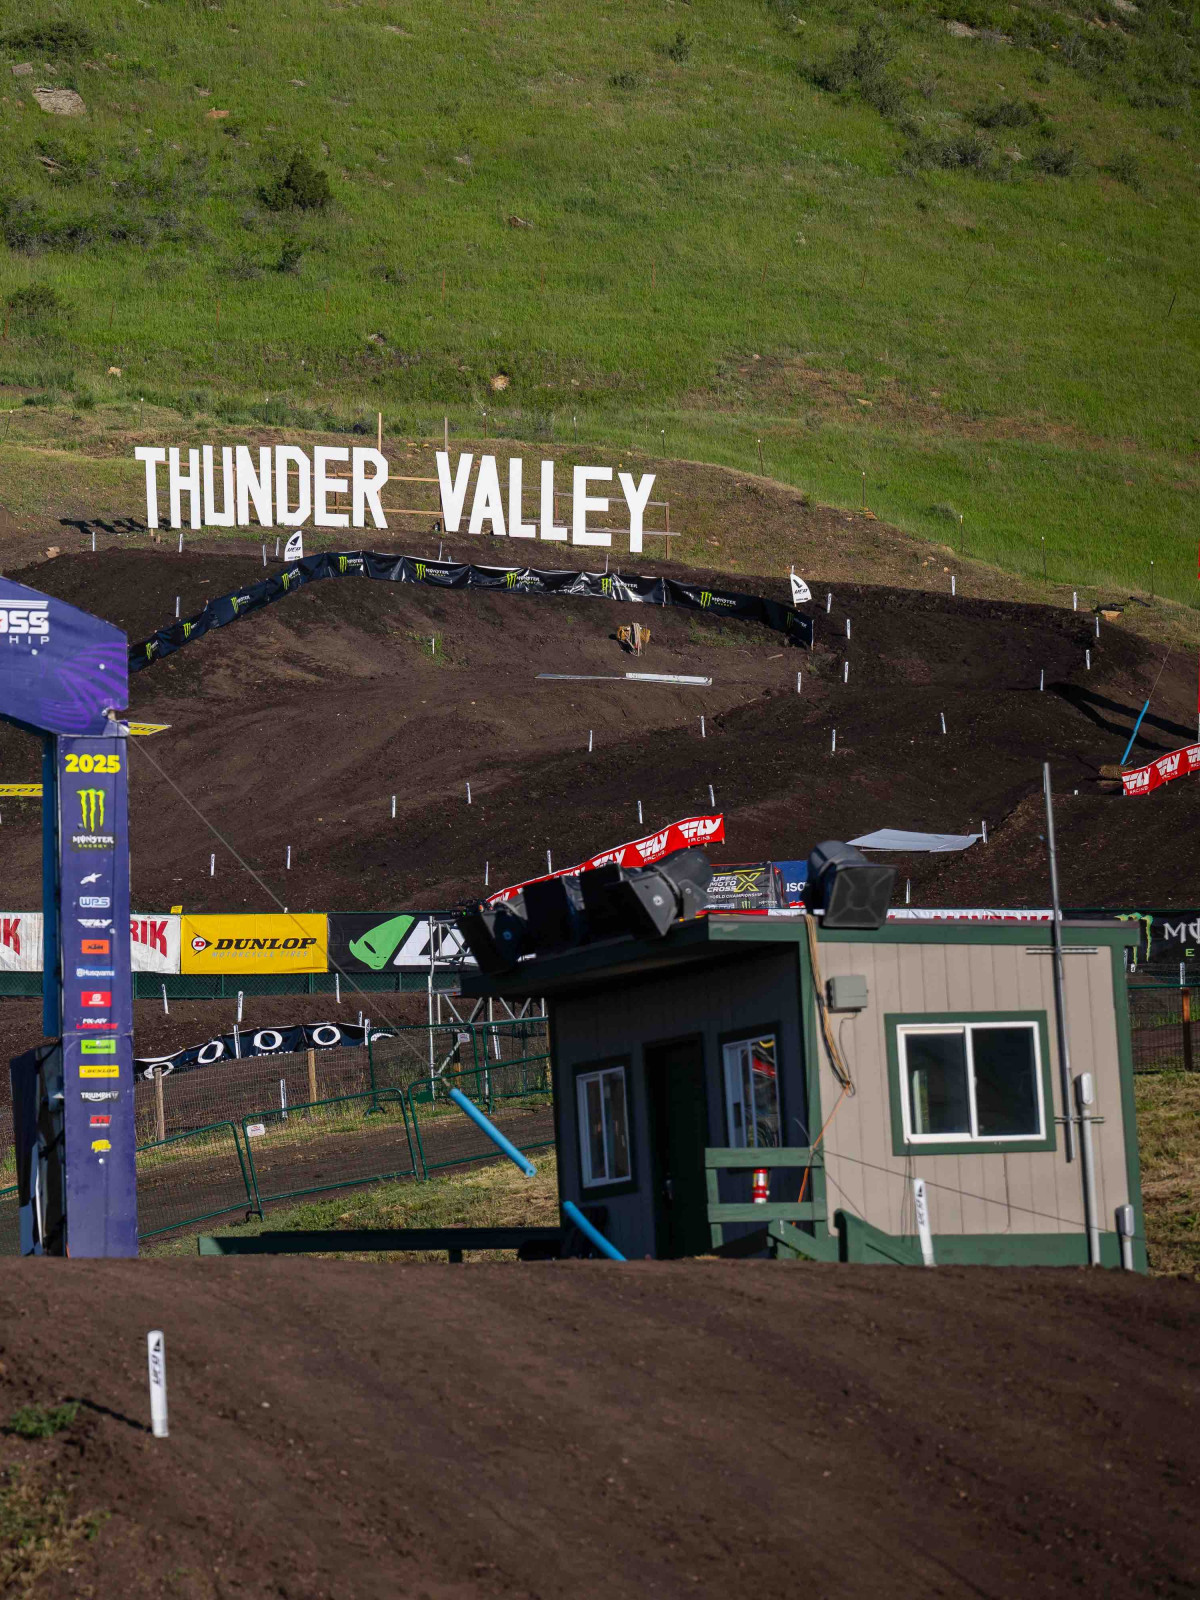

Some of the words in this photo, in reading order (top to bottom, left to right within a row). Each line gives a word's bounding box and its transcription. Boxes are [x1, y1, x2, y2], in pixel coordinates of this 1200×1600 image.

[134, 445, 389, 530] THUNDER
[436, 451, 657, 553] VALLEY
[65, 754, 121, 773] 2025
[1156, 753, 1180, 776] FLY
[1122, 768, 1151, 789] FLY
[678, 818, 722, 839] FLY
[72, 835, 114, 844] MONSTER
[636, 830, 669, 857] FLY
[79, 897, 110, 908] WPS
[214, 938, 317, 950] DUNLOP
[212, 950, 274, 958] MOTORCYCLE
[280, 950, 308, 958] TIRES
[81, 1092, 111, 1100] TRIUMPH
